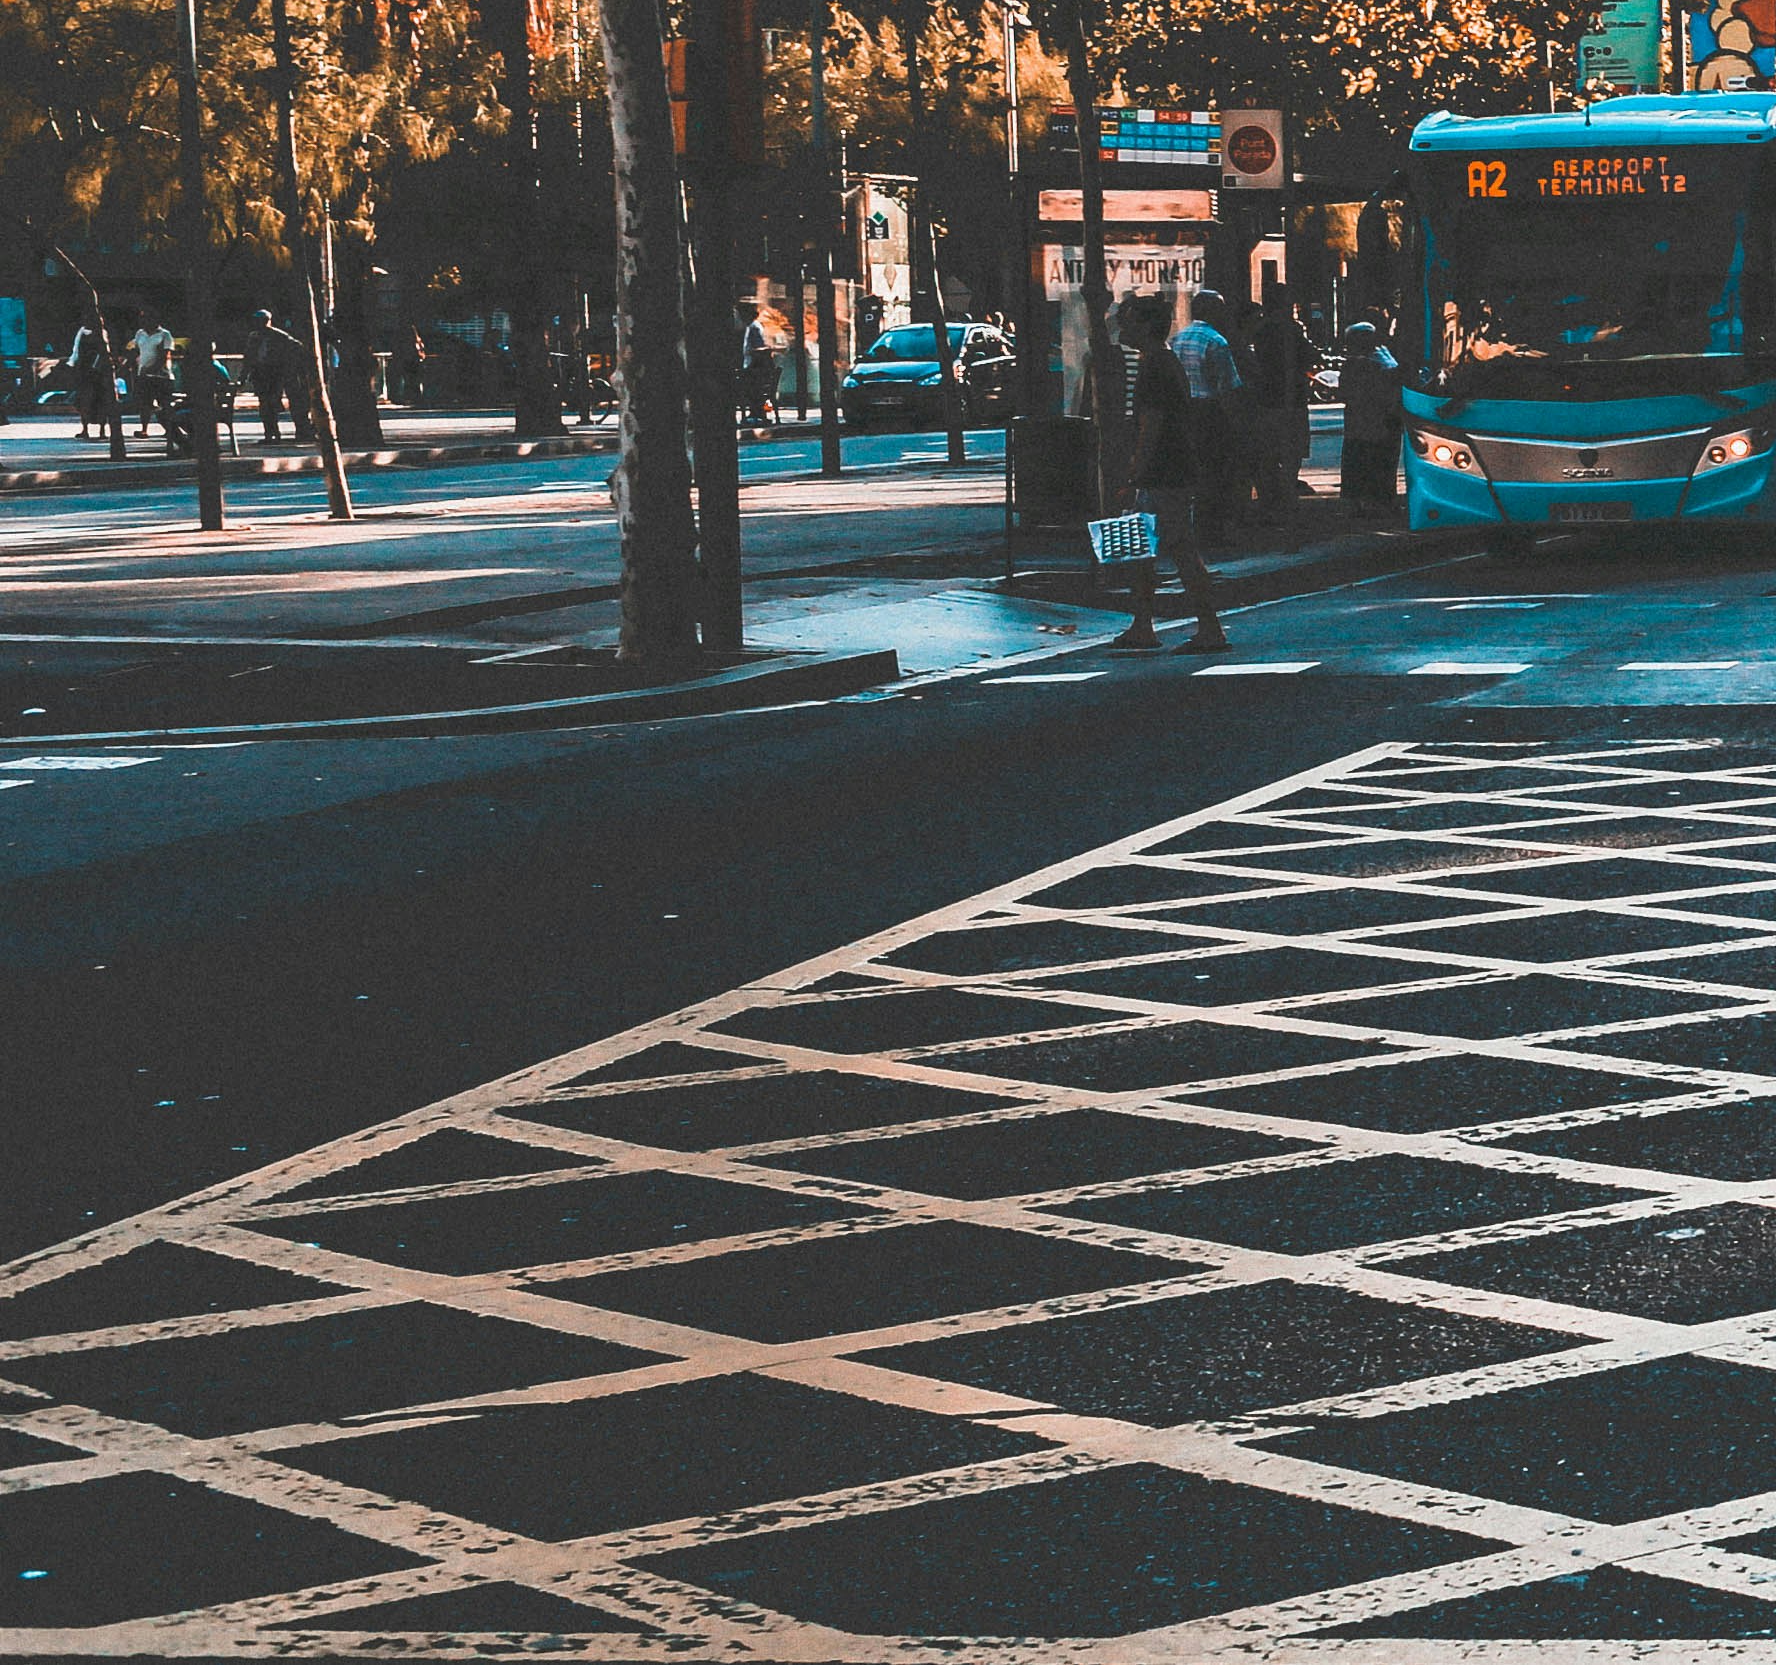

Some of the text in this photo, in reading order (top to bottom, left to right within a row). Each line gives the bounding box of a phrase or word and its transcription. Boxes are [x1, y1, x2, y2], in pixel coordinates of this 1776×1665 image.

[1467, 160, 1508, 198] A2
[1552, 156, 1669, 178] AEROPORT
[1537, 174, 1687, 197] TERMINAL T2
[1049, 258, 1204, 284] ANTY MORATO
